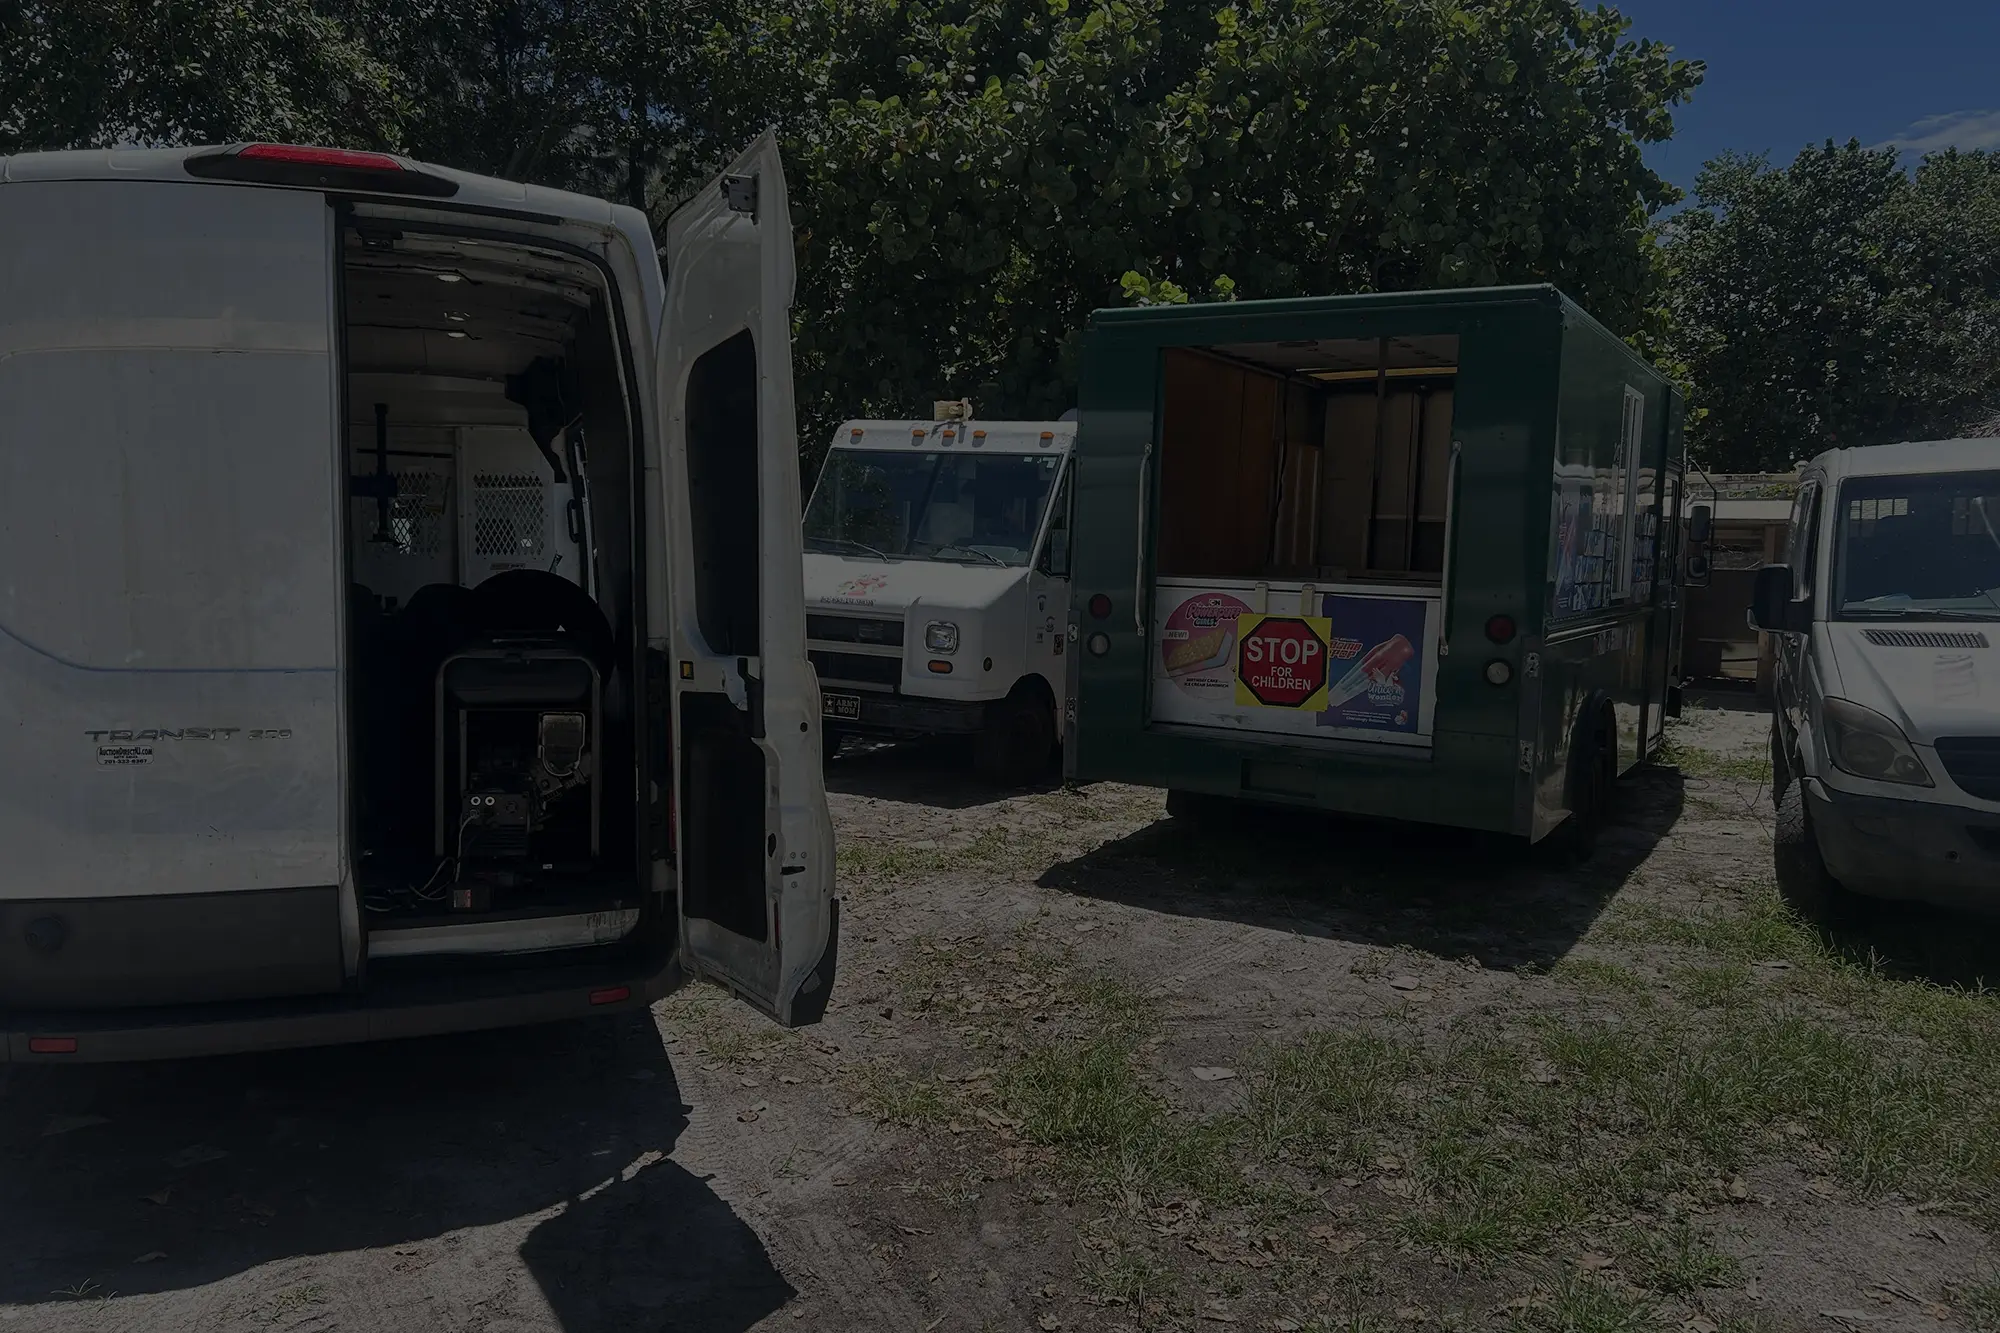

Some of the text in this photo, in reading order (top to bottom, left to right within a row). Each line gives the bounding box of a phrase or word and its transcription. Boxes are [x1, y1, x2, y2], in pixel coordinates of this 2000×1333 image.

[1247, 637, 1319, 664] STOP
[1271, 666, 1293, 678] FOR
[1252, 676, 1311, 691] CHILDREN
[84, 728, 240, 742] TRANSIT
